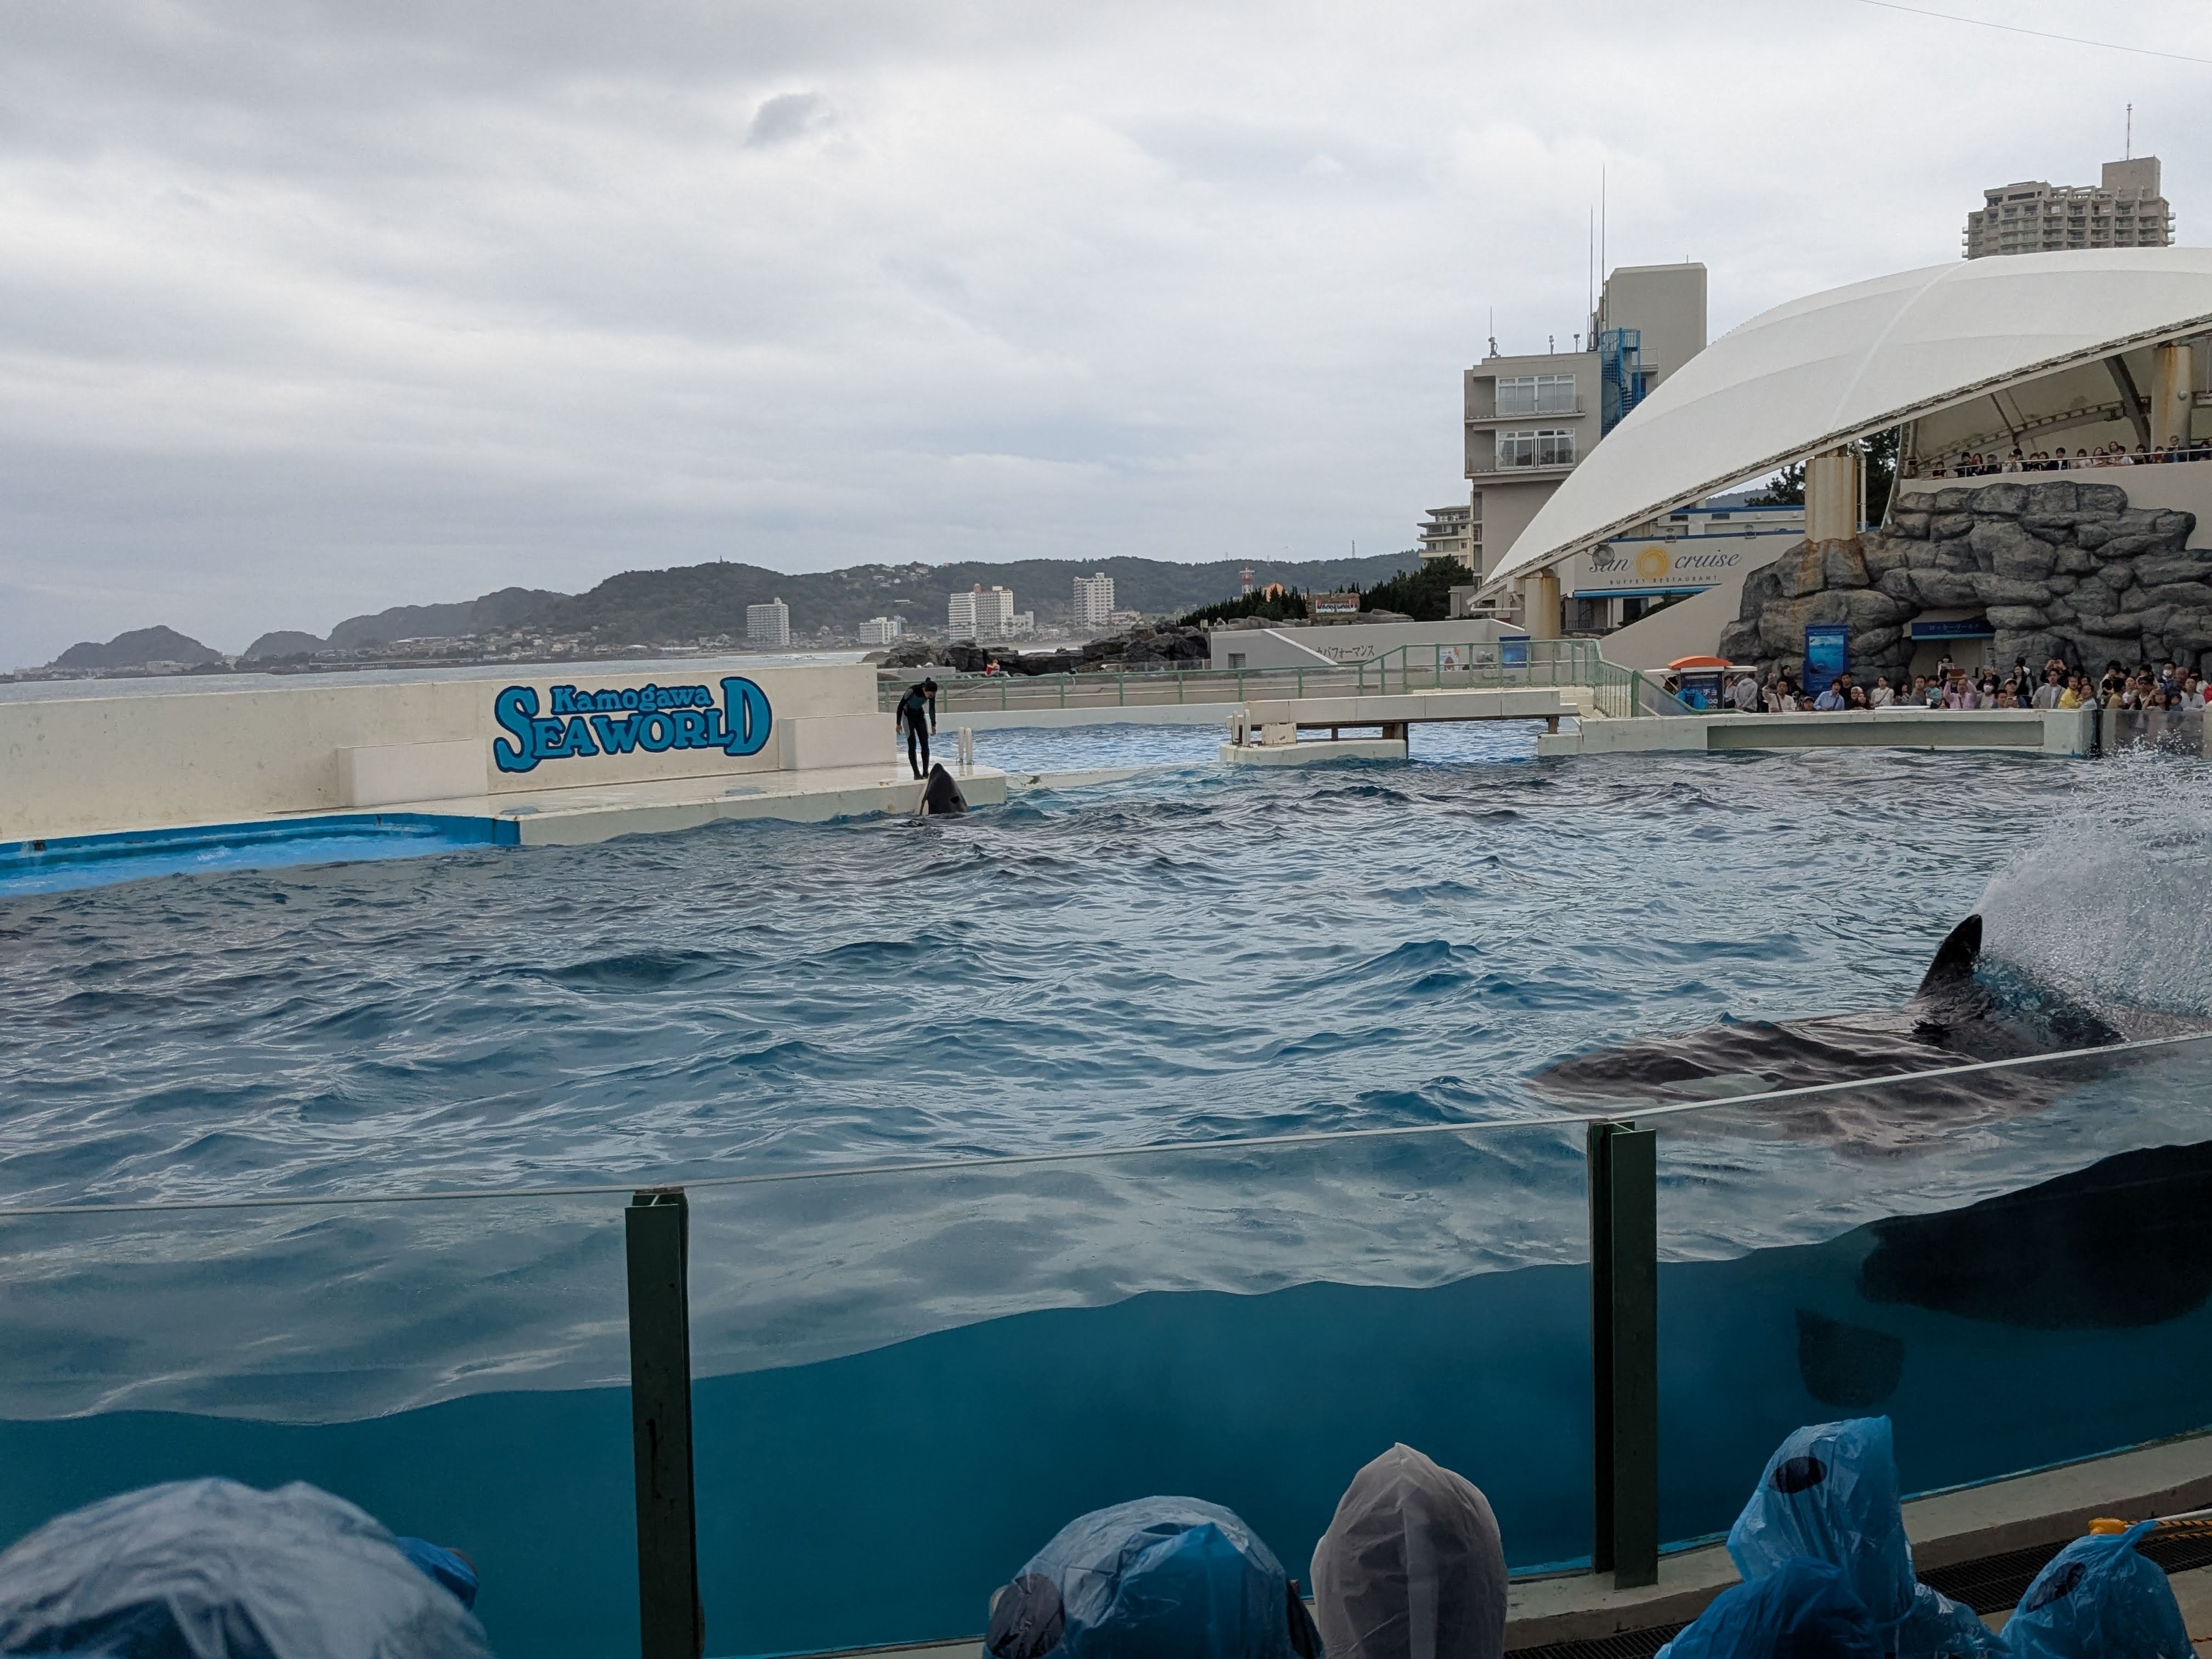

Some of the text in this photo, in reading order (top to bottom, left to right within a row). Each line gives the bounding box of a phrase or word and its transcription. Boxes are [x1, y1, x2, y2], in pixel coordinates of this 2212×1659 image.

[1674, 549, 1743, 569] cruise
[1652, 575, 1718, 583] RESTAURANT
[550, 684, 713, 714] Kamogawa
